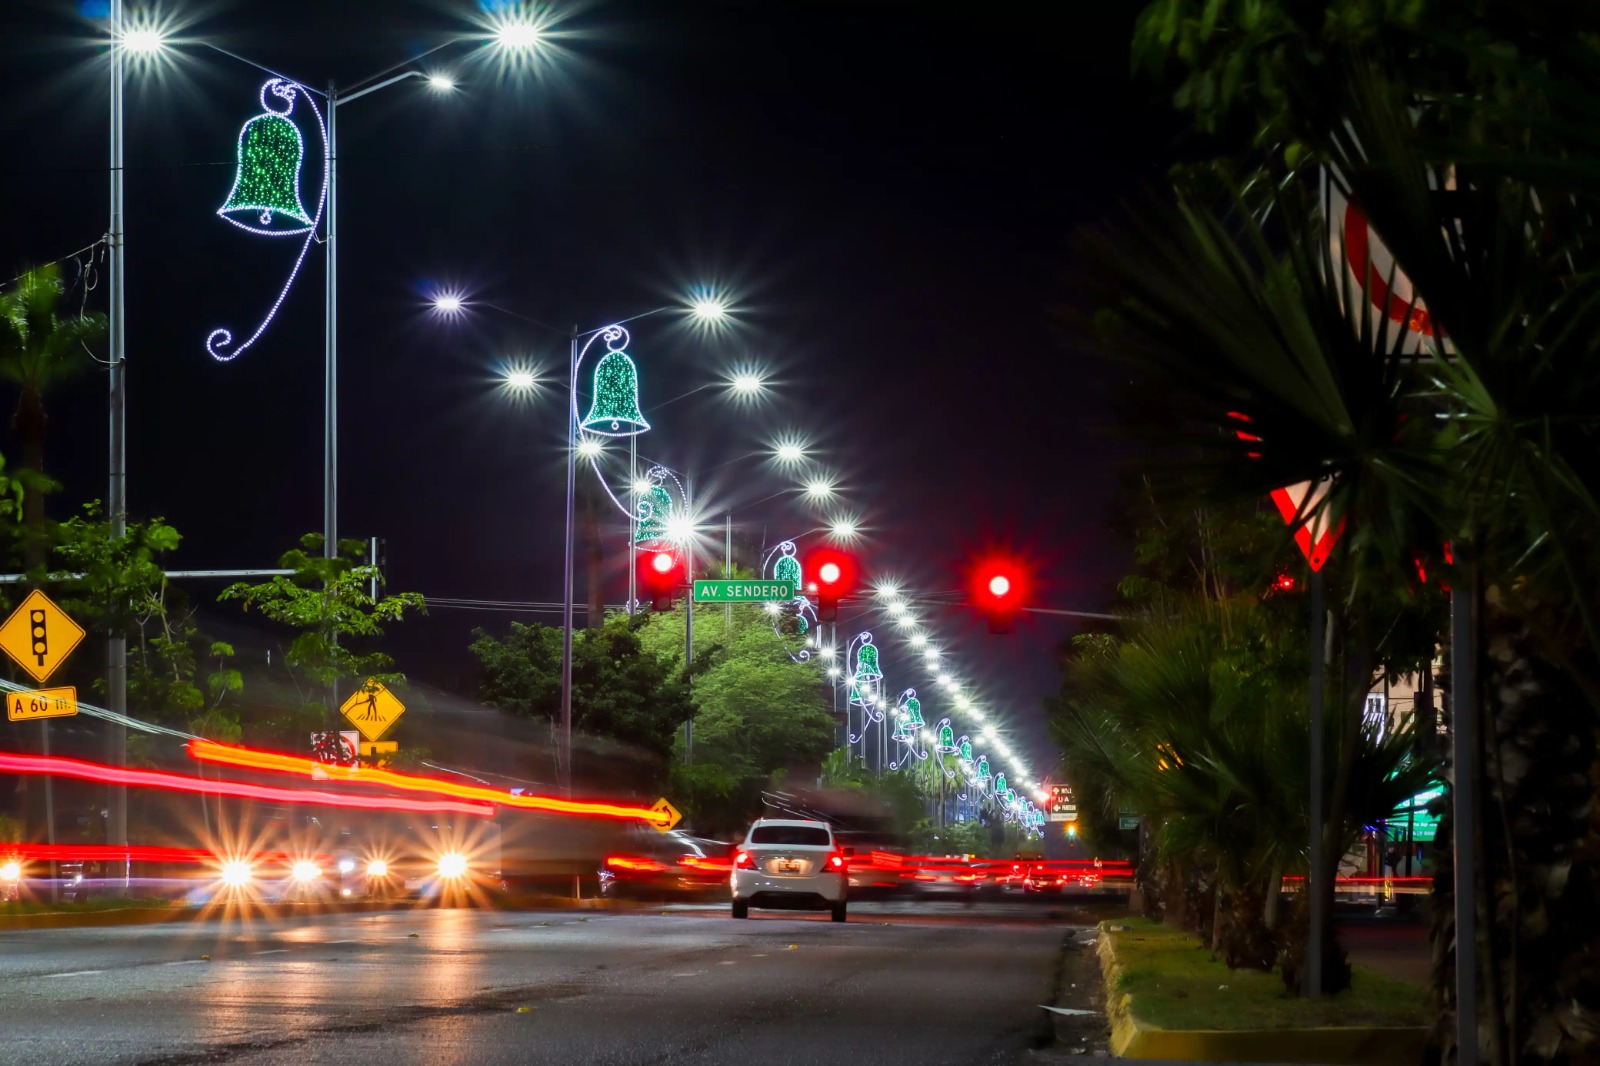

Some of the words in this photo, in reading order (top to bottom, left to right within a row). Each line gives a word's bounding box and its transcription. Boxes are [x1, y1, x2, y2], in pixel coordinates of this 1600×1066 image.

[701, 585, 721, 597] AV.
[726, 585, 788, 597] SENDERO
[14, 698, 24, 714] A
[30, 695, 48, 712] 60
